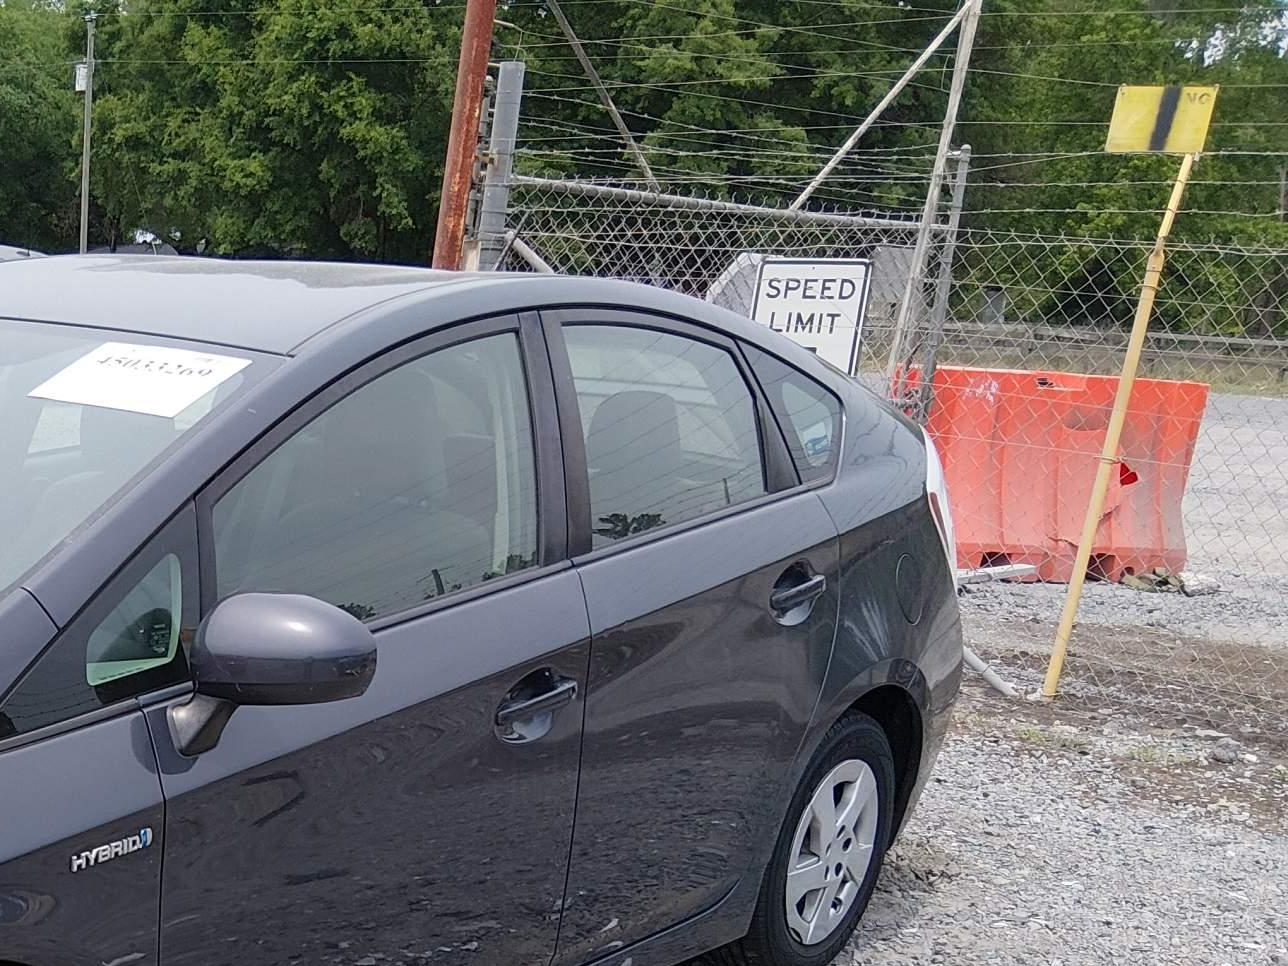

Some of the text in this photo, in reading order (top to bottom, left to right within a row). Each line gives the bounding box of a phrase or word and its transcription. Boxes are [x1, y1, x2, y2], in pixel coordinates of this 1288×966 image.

[765, 277, 856, 300] SPEED
[769, 312, 842, 335] LIMIT
[70, 834, 141, 873] HYBRID
